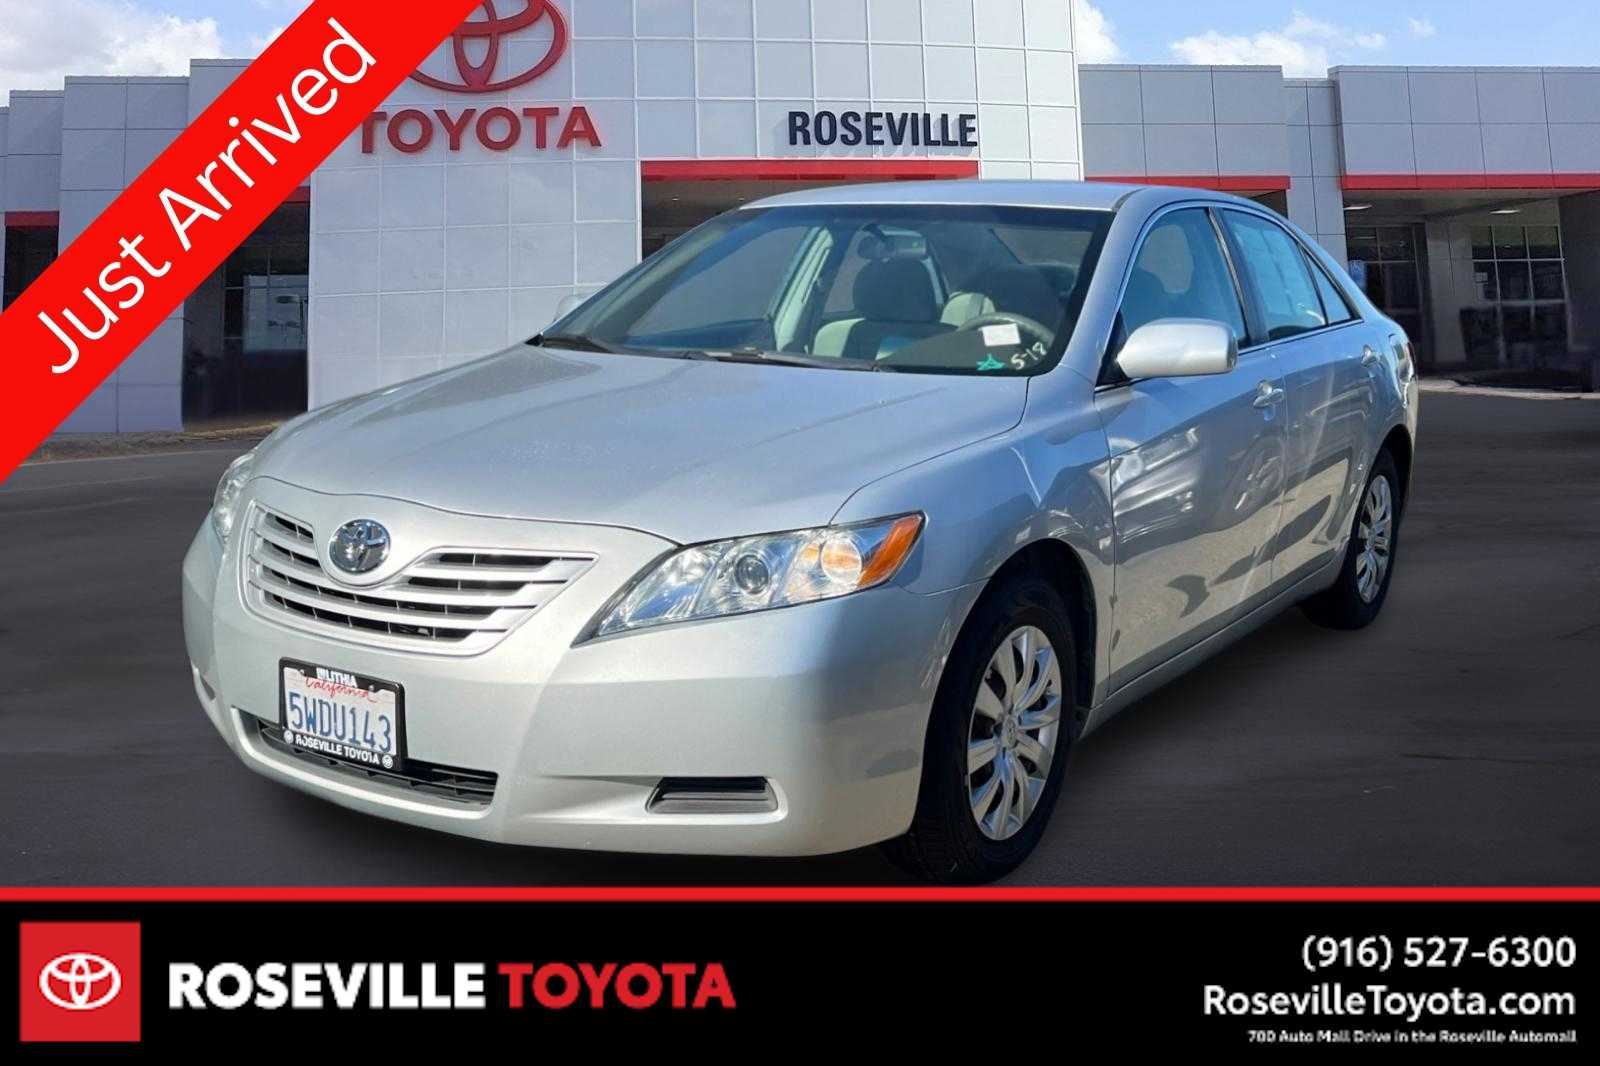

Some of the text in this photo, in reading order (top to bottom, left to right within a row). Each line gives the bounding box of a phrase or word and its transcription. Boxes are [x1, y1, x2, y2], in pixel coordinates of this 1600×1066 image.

[361, 106, 602, 154] TOYOTA
[787, 110, 978, 147] ROSEVILLE
[289, 691, 392, 753] 5WDU143
[295, 735, 380, 765] ROSEVILLE TOYOTA
